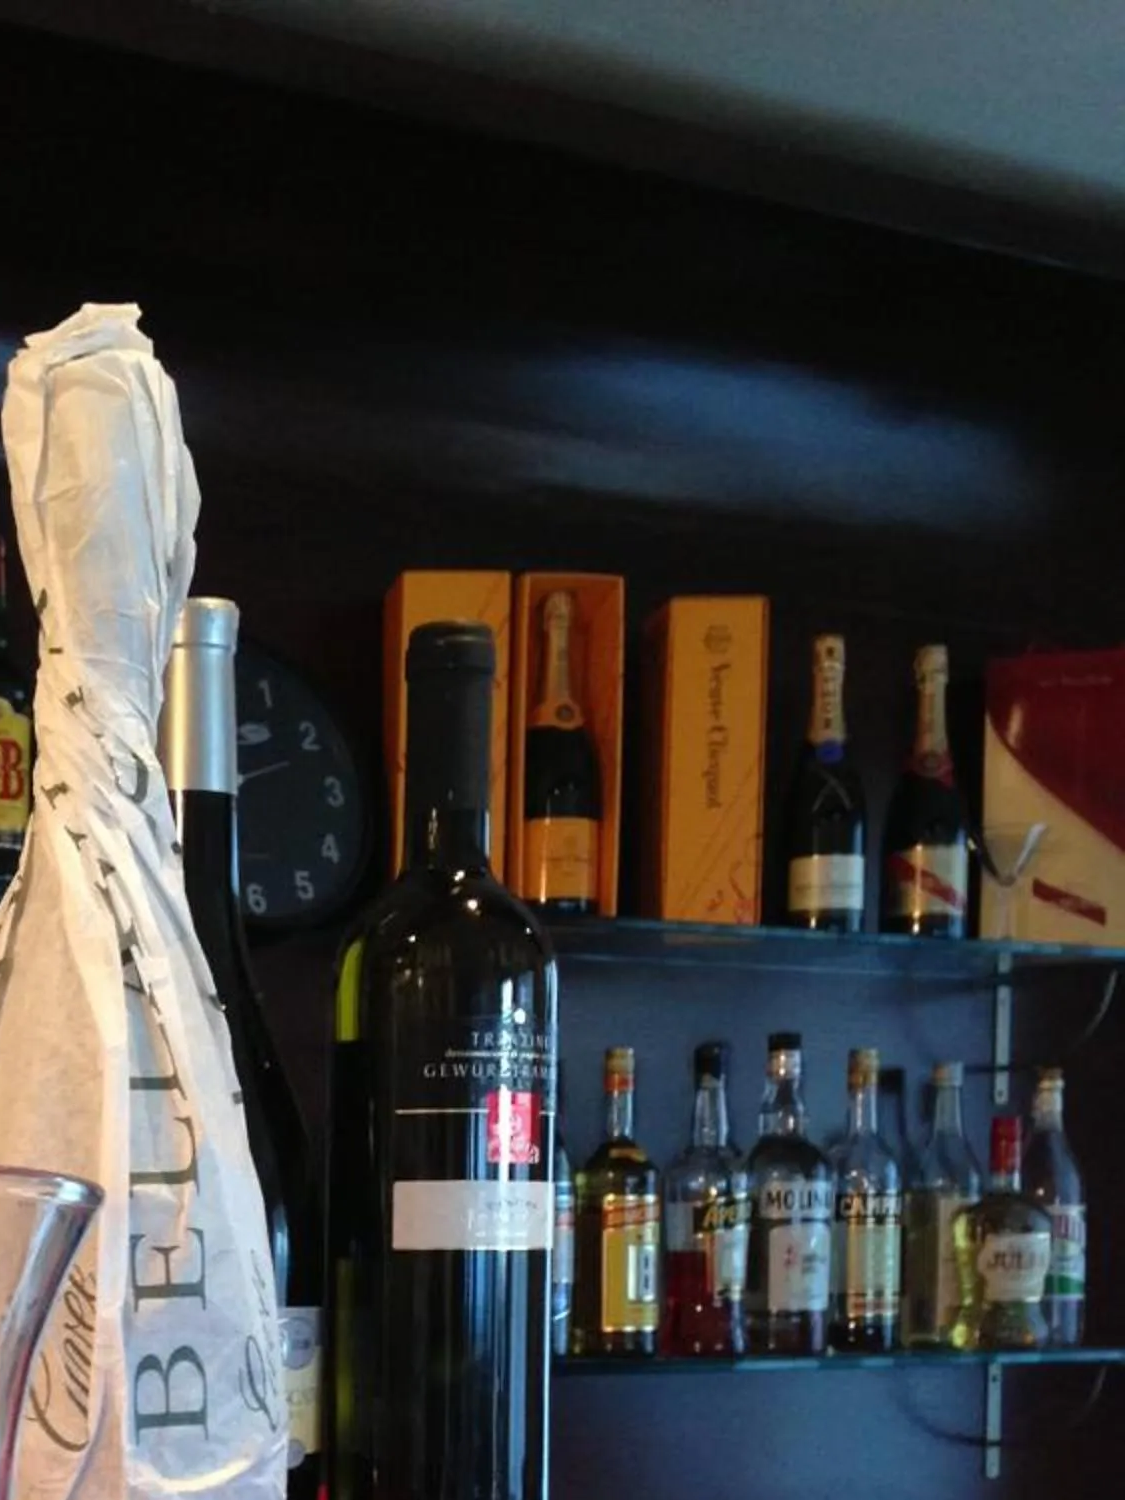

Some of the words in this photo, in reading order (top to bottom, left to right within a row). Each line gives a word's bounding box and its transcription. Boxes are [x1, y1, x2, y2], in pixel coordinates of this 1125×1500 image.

[298, 721, 321, 751] 2
[324, 776, 344, 808] 3
[321, 833, 340, 864] 4
[246, 883, 268, 914] 6
[294, 870, 315, 901] 5
